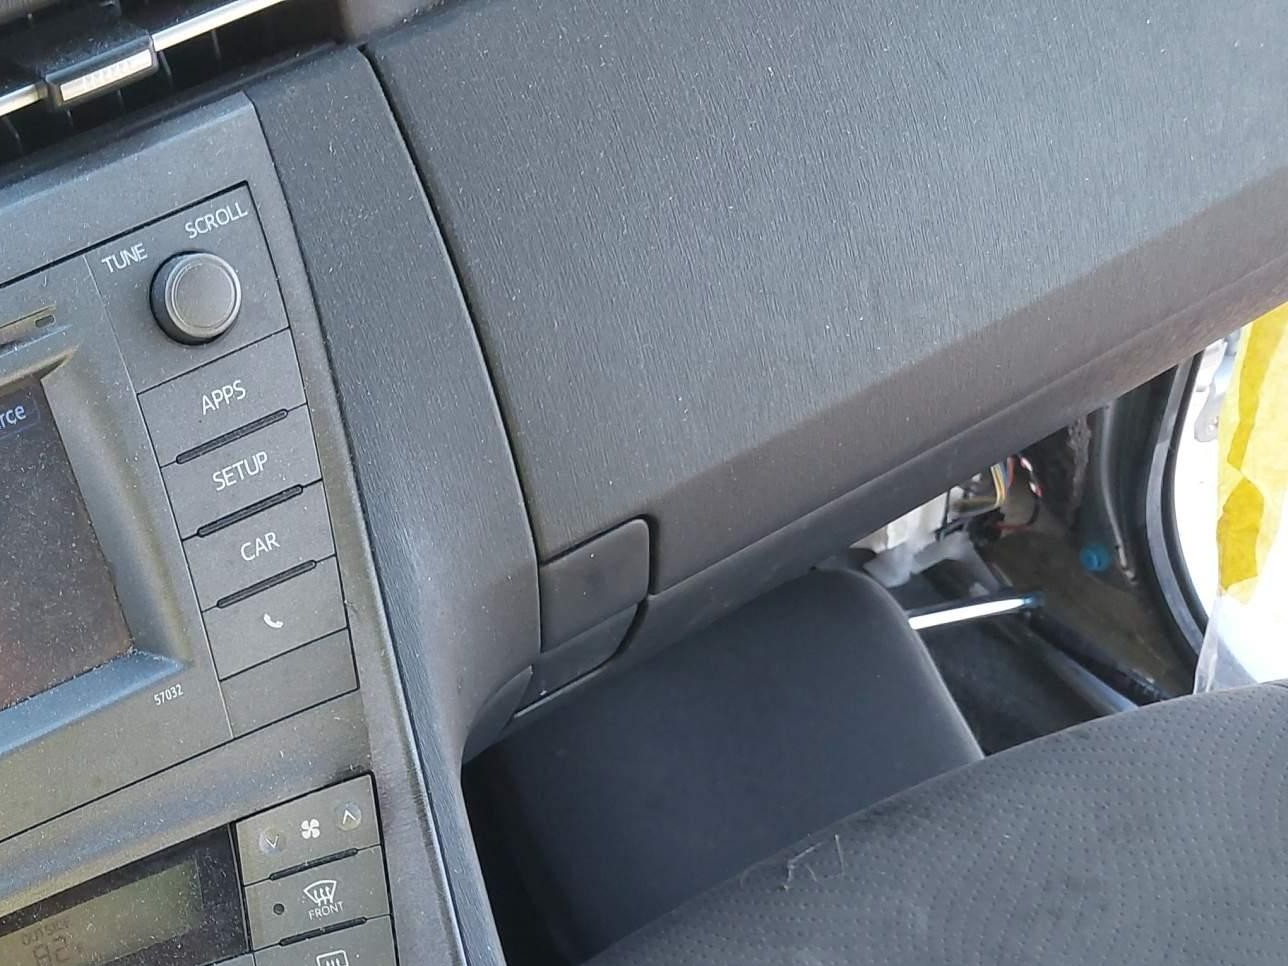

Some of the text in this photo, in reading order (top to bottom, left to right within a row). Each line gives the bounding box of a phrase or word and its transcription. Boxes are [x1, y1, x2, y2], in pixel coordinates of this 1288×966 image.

[185, 202, 249, 239] SCROLL
[101, 243, 149, 274] TUNE
[200, 380, 247, 415] APPS
[212, 451, 269, 491] SETUP
[240, 532, 280, 563] CAR
[153, 683, 184, 706] 57032
[308, 901, 344, 920] FRONT
